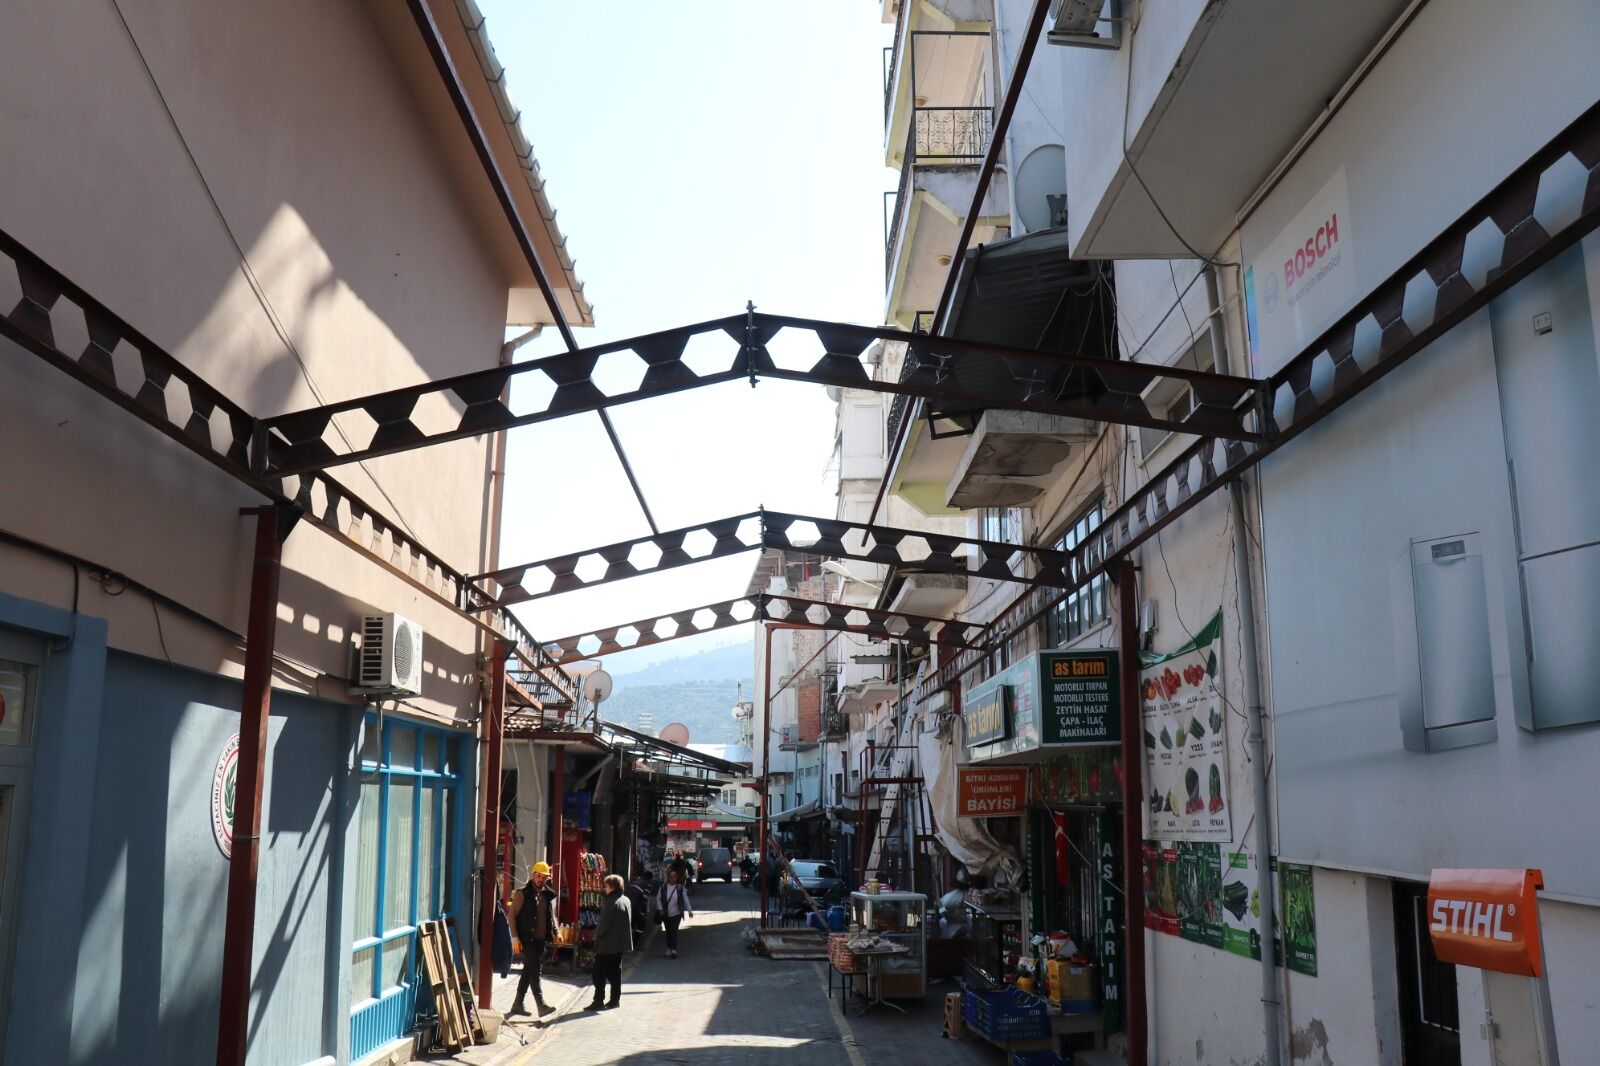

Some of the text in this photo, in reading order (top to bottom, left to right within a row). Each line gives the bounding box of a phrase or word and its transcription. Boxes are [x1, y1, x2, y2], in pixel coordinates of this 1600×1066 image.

[1284, 212, 1339, 290] BOSCH
[1054, 660, 1105, 676] as tarım
[1054, 681, 1107, 692] MOTORLU TIRPAN
[1053, 693, 1109, 703] MOTORLU TESTERE
[1056, 704, 1107, 715] ZEYTİN HASAT
[968, 712, 977, 738] as
[1060, 716, 1080, 728] ÇAPA
[1086, 715, 1104, 727] İLAÇ
[1060, 726, 1107, 738] MAKİNALARI
[966, 773, 1020, 783] BİTKİ KORUMA
[974, 783, 1012, 794] ÜRÜNLERİ
[967, 794, 1017, 812] BAYİSİ
